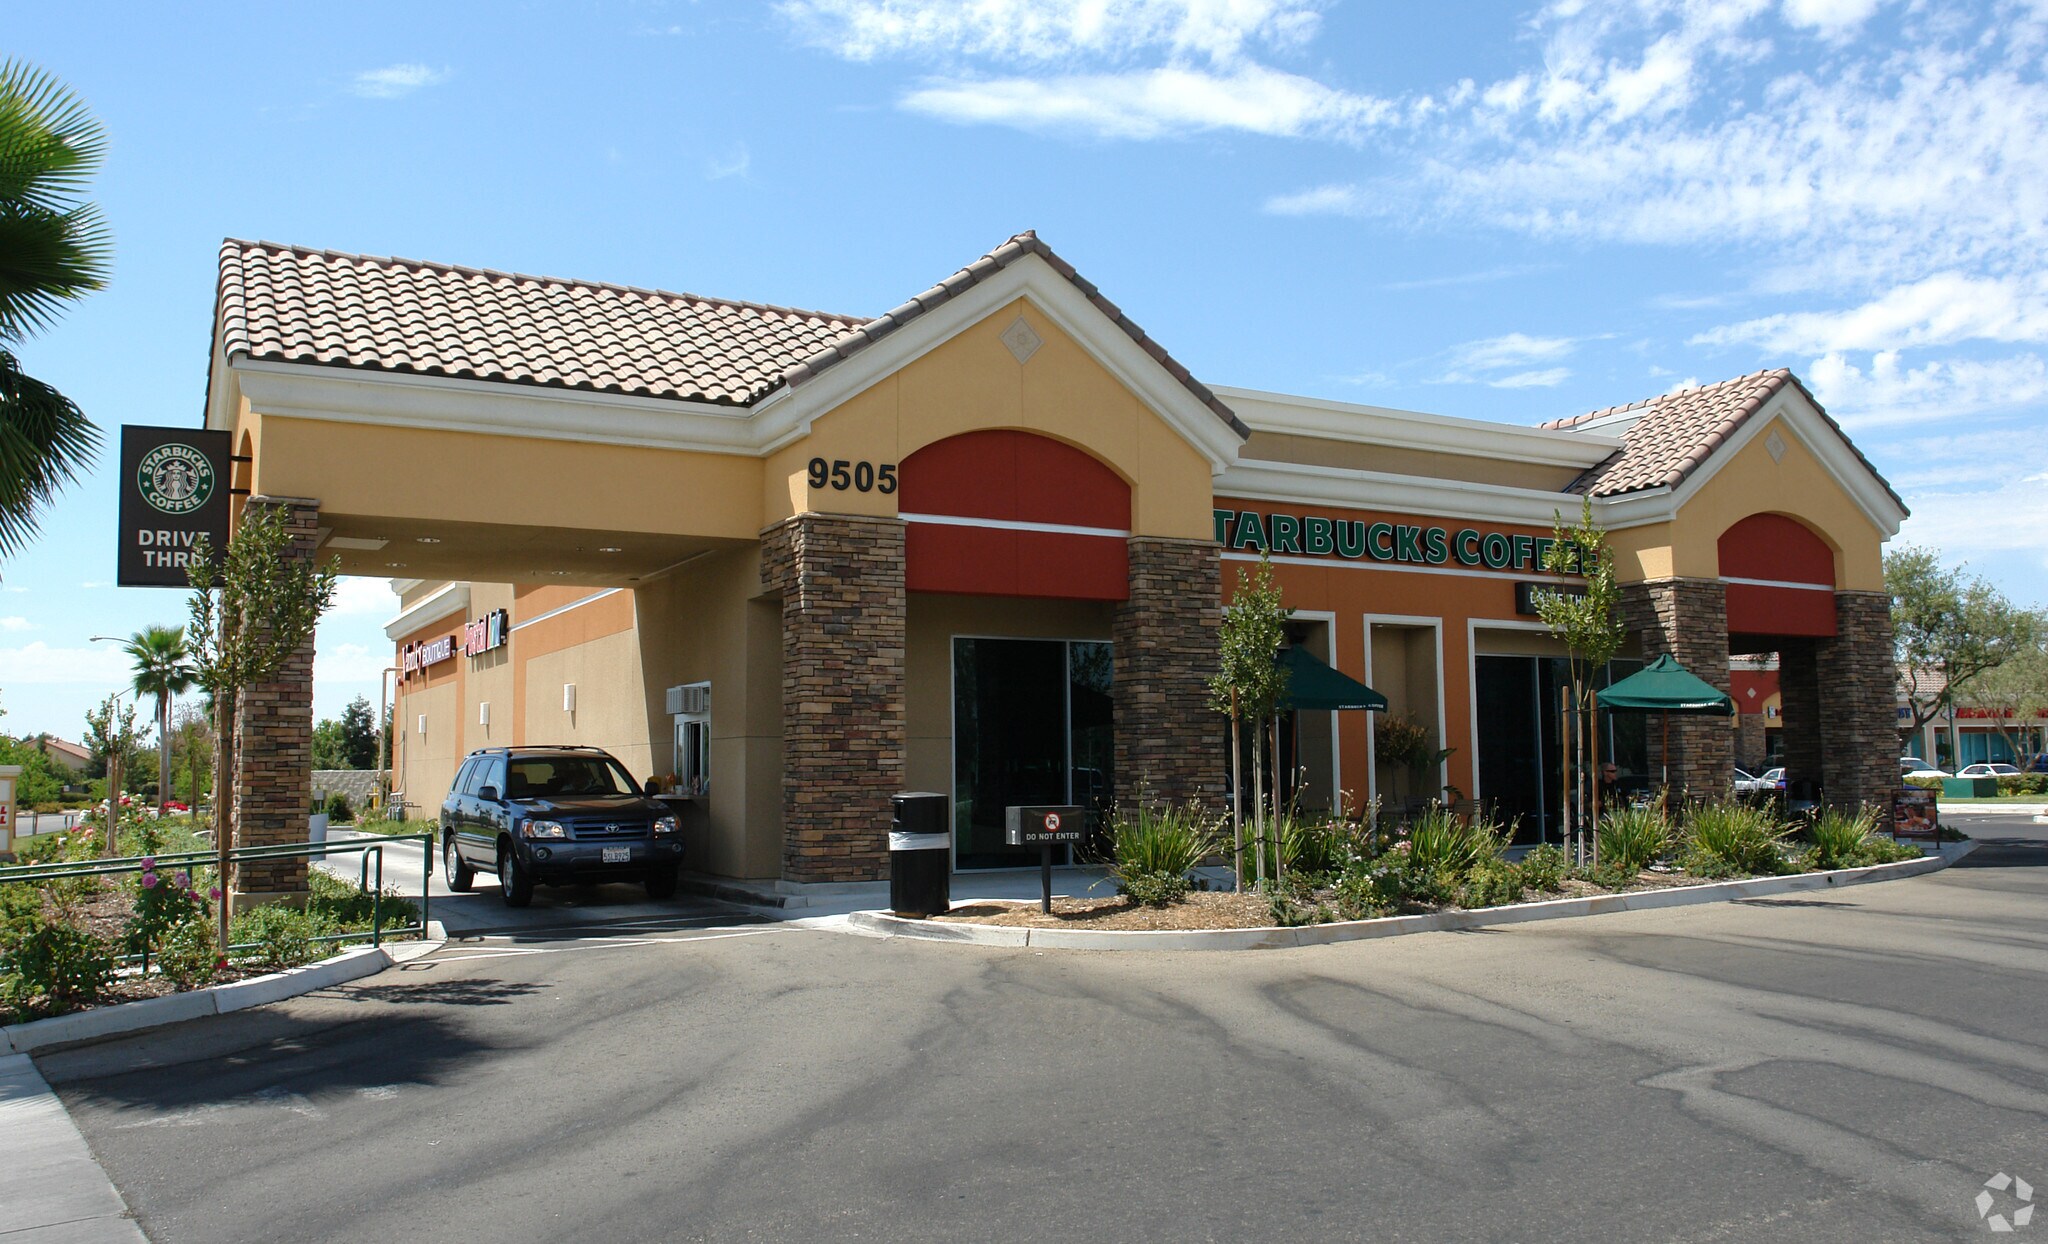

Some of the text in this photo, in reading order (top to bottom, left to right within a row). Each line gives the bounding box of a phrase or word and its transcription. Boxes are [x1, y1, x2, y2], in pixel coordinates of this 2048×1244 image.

[142, 446, 211, 478] STARBUCKS
[808, 457, 897, 494] 9505
[149, 492, 202, 511] COFFEE
[1213, 508, 1448, 564] TARBUCKS
[1039, 832, 1054, 840] NOT
[1056, 832, 1080, 840] ENTER
